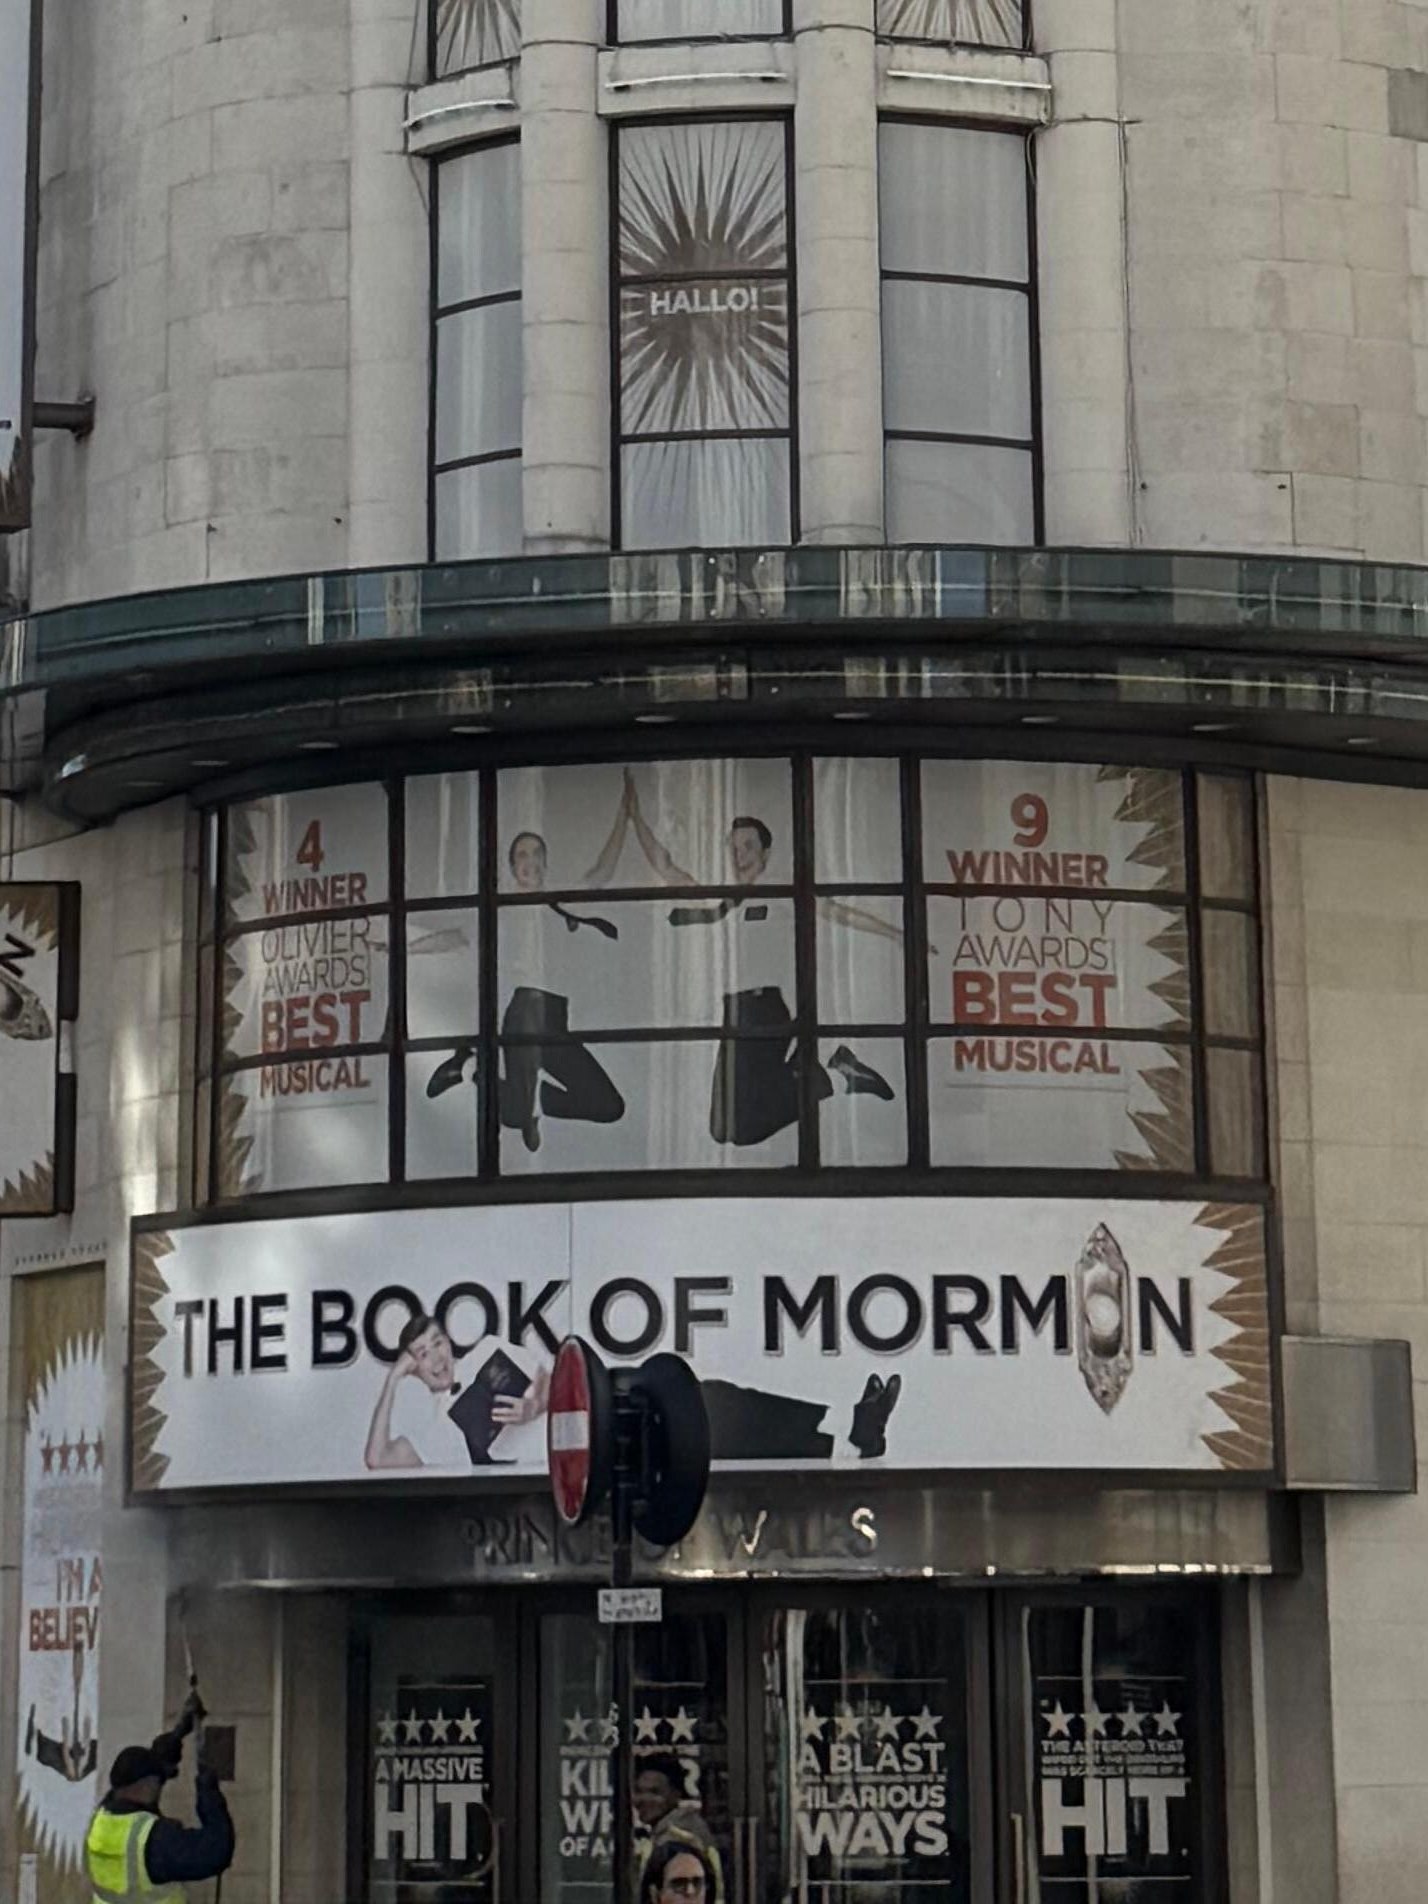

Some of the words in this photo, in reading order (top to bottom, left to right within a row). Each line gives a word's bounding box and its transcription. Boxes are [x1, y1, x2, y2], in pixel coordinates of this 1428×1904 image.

[650, 286, 760, 316] HALLO!
[1010, 792, 1050, 848] 9
[297, 818, 324, 874] 4
[946, 850, 1110, 888] WINNER
[262, 872, 368, 915] WINNER
[261, 914, 370, 964] OLIVIER
[952, 936, 1110, 970] AWARDS
[262, 955, 368, 994] AWARDS
[952, 970, 1118, 1028] BEST
[261, 991, 372, 1054] BEST
[954, 1039, 1121, 1074] MUSICAL
[260, 1058, 370, 1100] MUSICAL
[174, 1292, 289, 1379] THE
[311, 1278, 572, 1370] BOOK
[590, 1275, 733, 1357] OF
[375, 1757, 391, 1782] A
[392, 1757, 484, 1782] MASSIVE
[797, 1742, 821, 1774] A
[796, 1784, 947, 1810] HILARIOUS
[559, 1836, 589, 1858] OF
